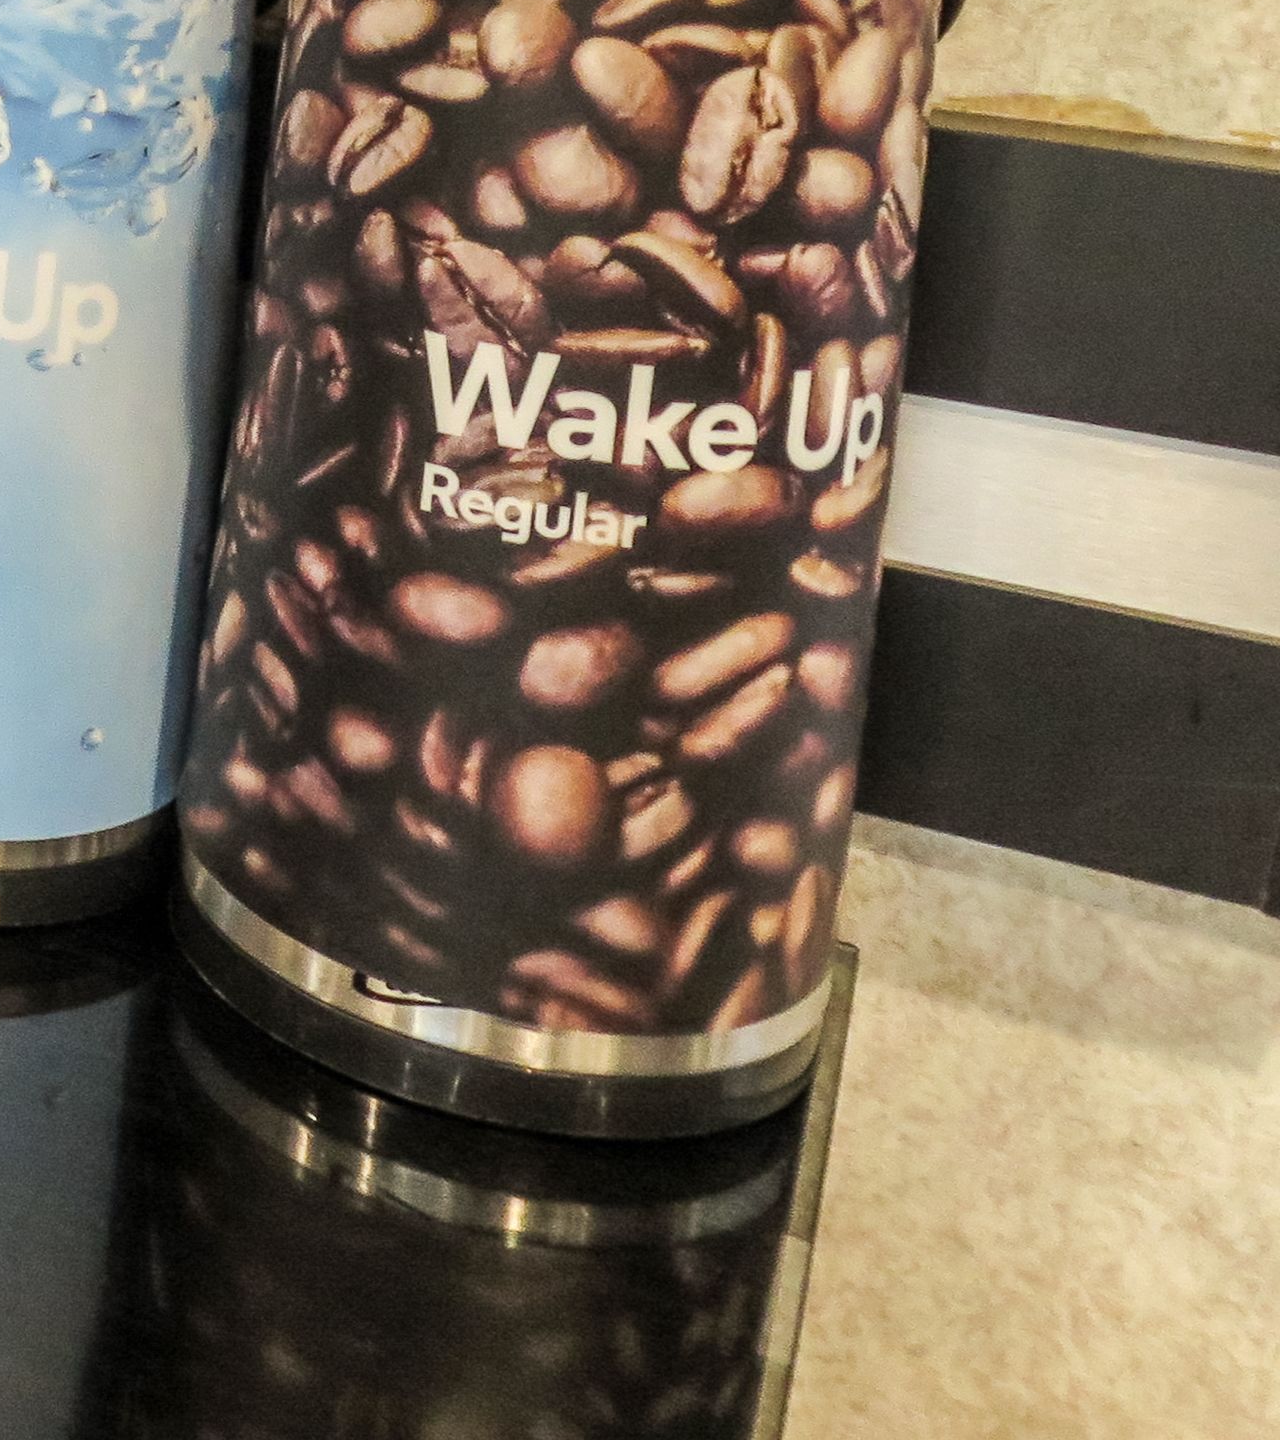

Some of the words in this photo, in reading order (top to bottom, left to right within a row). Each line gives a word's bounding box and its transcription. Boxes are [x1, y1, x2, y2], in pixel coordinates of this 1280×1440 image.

[423, 329, 759, 473] Wake
[785, 366, 883, 488] Up
[419, 461, 648, 549] Regular
